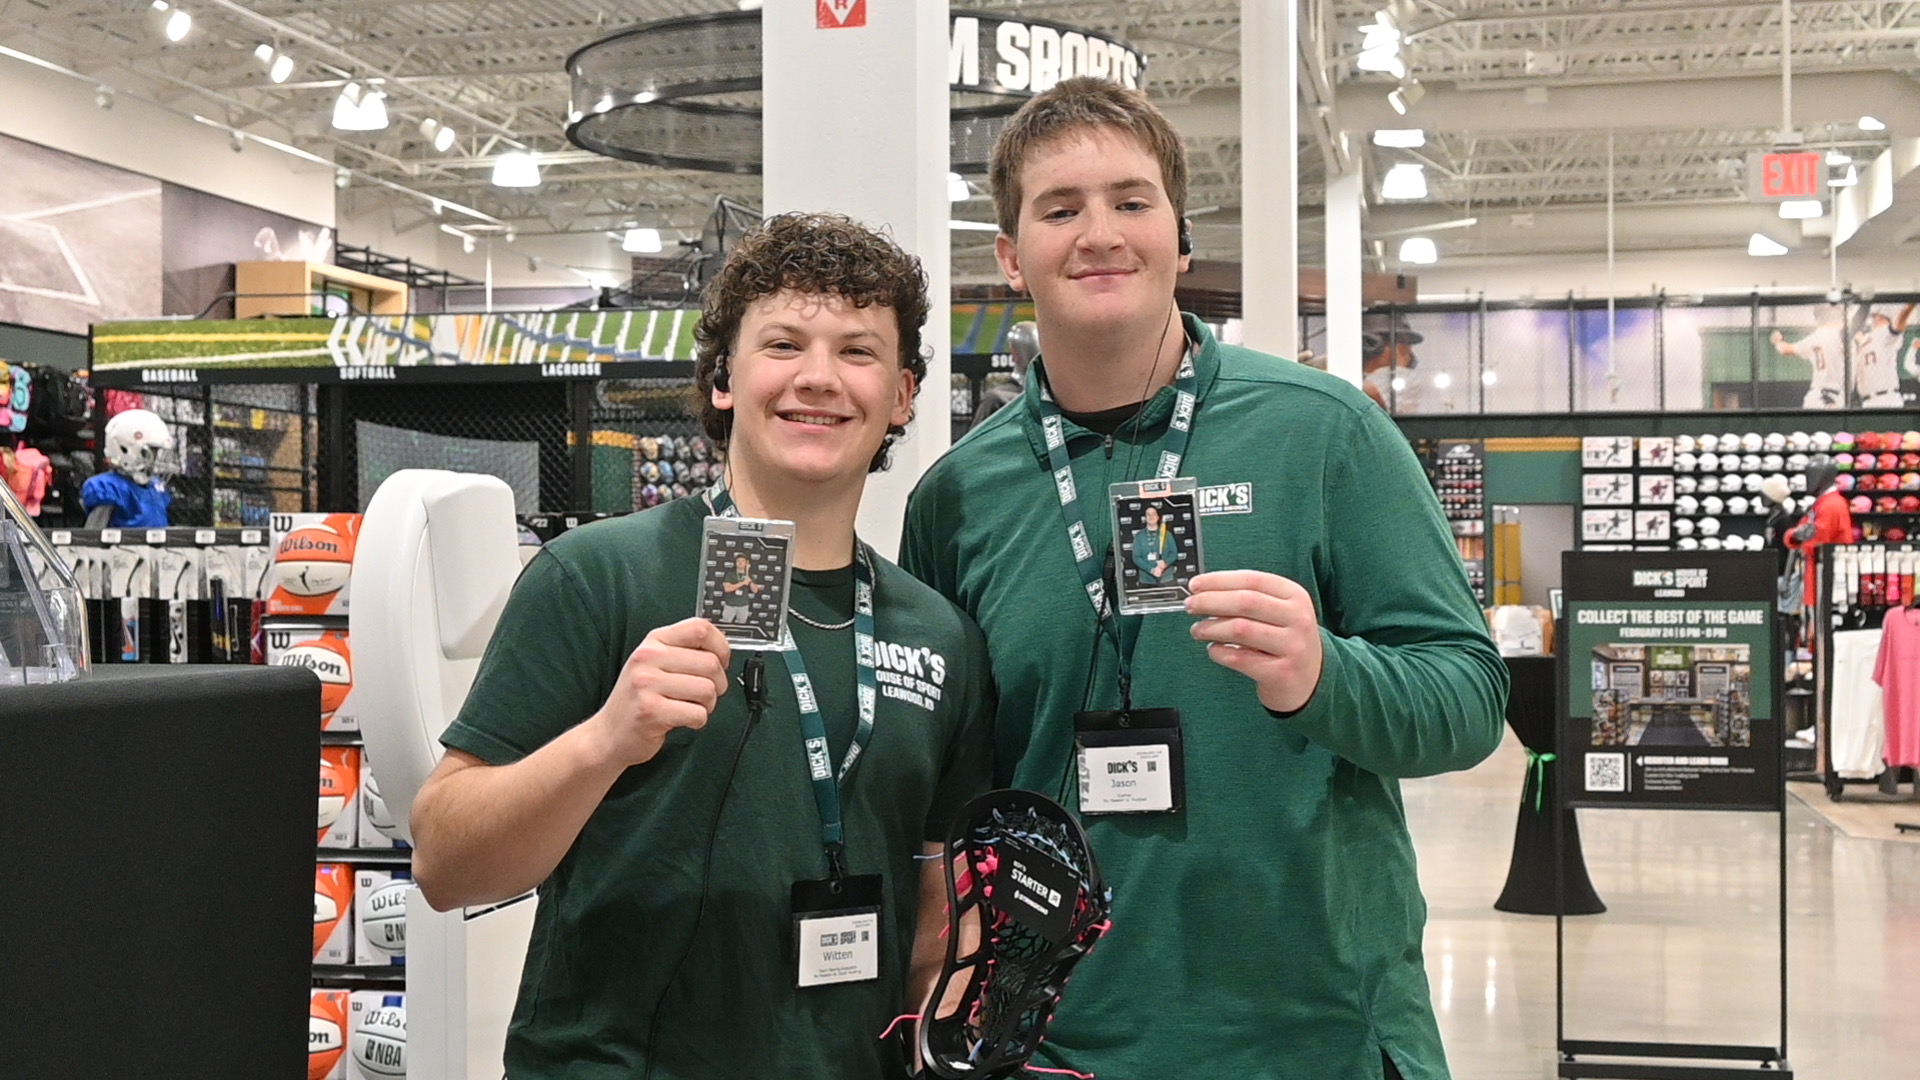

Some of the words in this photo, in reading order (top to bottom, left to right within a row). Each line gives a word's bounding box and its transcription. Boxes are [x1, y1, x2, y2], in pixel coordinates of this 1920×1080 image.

[995, 20, 1139, 94] SPORTS
[1763, 154, 1821, 196] EXIT
[141, 369, 198, 383] BASEBALL
[339, 366, 396, 380] SOFTBALL
[541, 362, 601, 377] LACROSSE
[1199, 484, 1249, 508] ICK'S
[279, 535, 339, 554] Wilson
[1633, 570, 1674, 586] DICK'S
[1577, 610, 1628, 624] COLLECT
[1631, 610, 1653, 624] THE
[1654, 610, 1684, 624] BEST
[1686, 610, 1703, 624] OF
[1705, 610, 1726, 624] THE
[1728, 610, 1763, 624] GAME
[1619, 627, 1661, 638] FEBRUARY
[1662, 627, 1674, 638] 24
[1686, 628, 1700, 638] PM
[1712, 628, 1727, 638] PM
[876, 670, 903, 686] OUSE
[903, 675, 915, 689] OF
[916, 680, 941, 701] SPORT
[1107, 760, 1138, 774] DICK'S
[1111, 779, 1137, 788] Jason
[1011, 868, 1049, 899] STARTER
[823, 950, 853, 961] Witten
[375, 1042, 402, 1067] NBA
